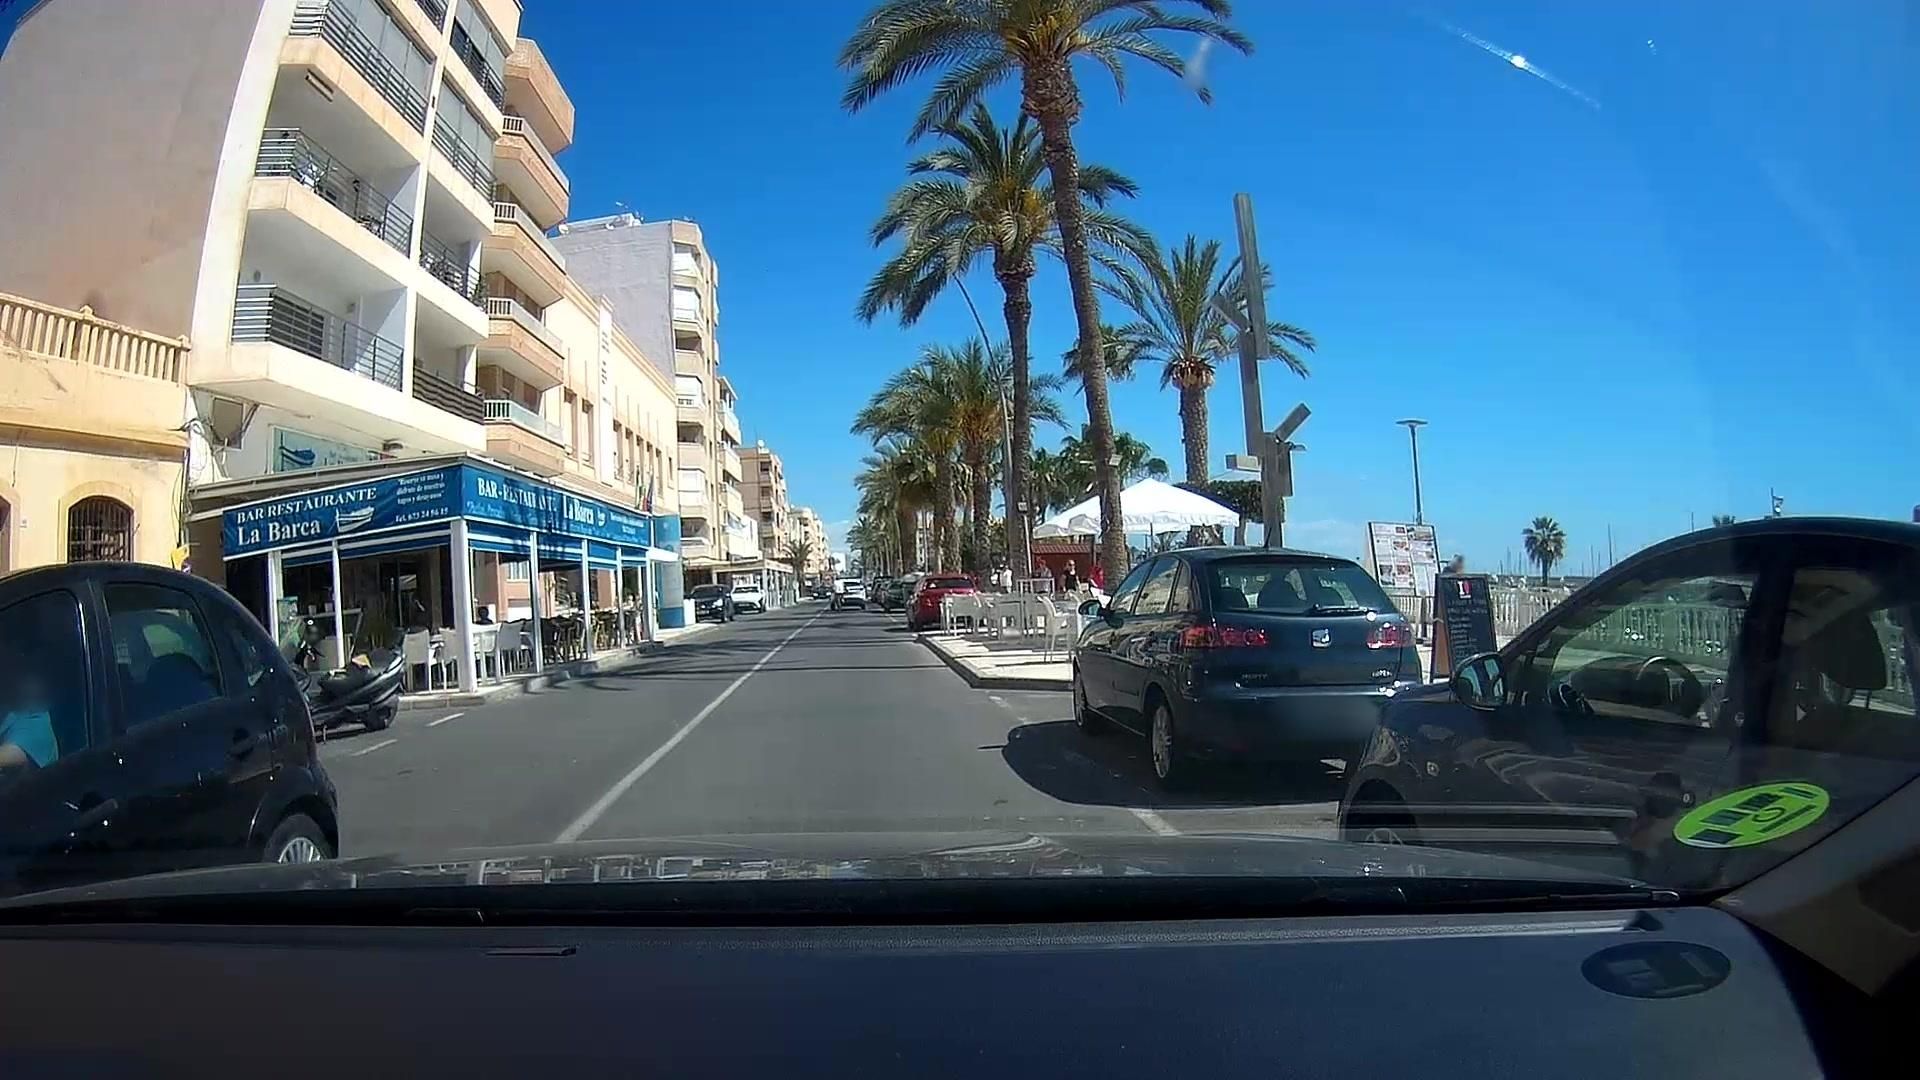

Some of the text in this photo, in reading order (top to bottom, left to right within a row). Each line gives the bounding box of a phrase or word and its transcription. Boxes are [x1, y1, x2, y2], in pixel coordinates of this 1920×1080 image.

[237, 487, 377, 524] BAR RESTAURANTE
[563, 495, 574, 519] La
[574, 499, 594, 525] Barca
[238, 519, 321, 546] La Barca
